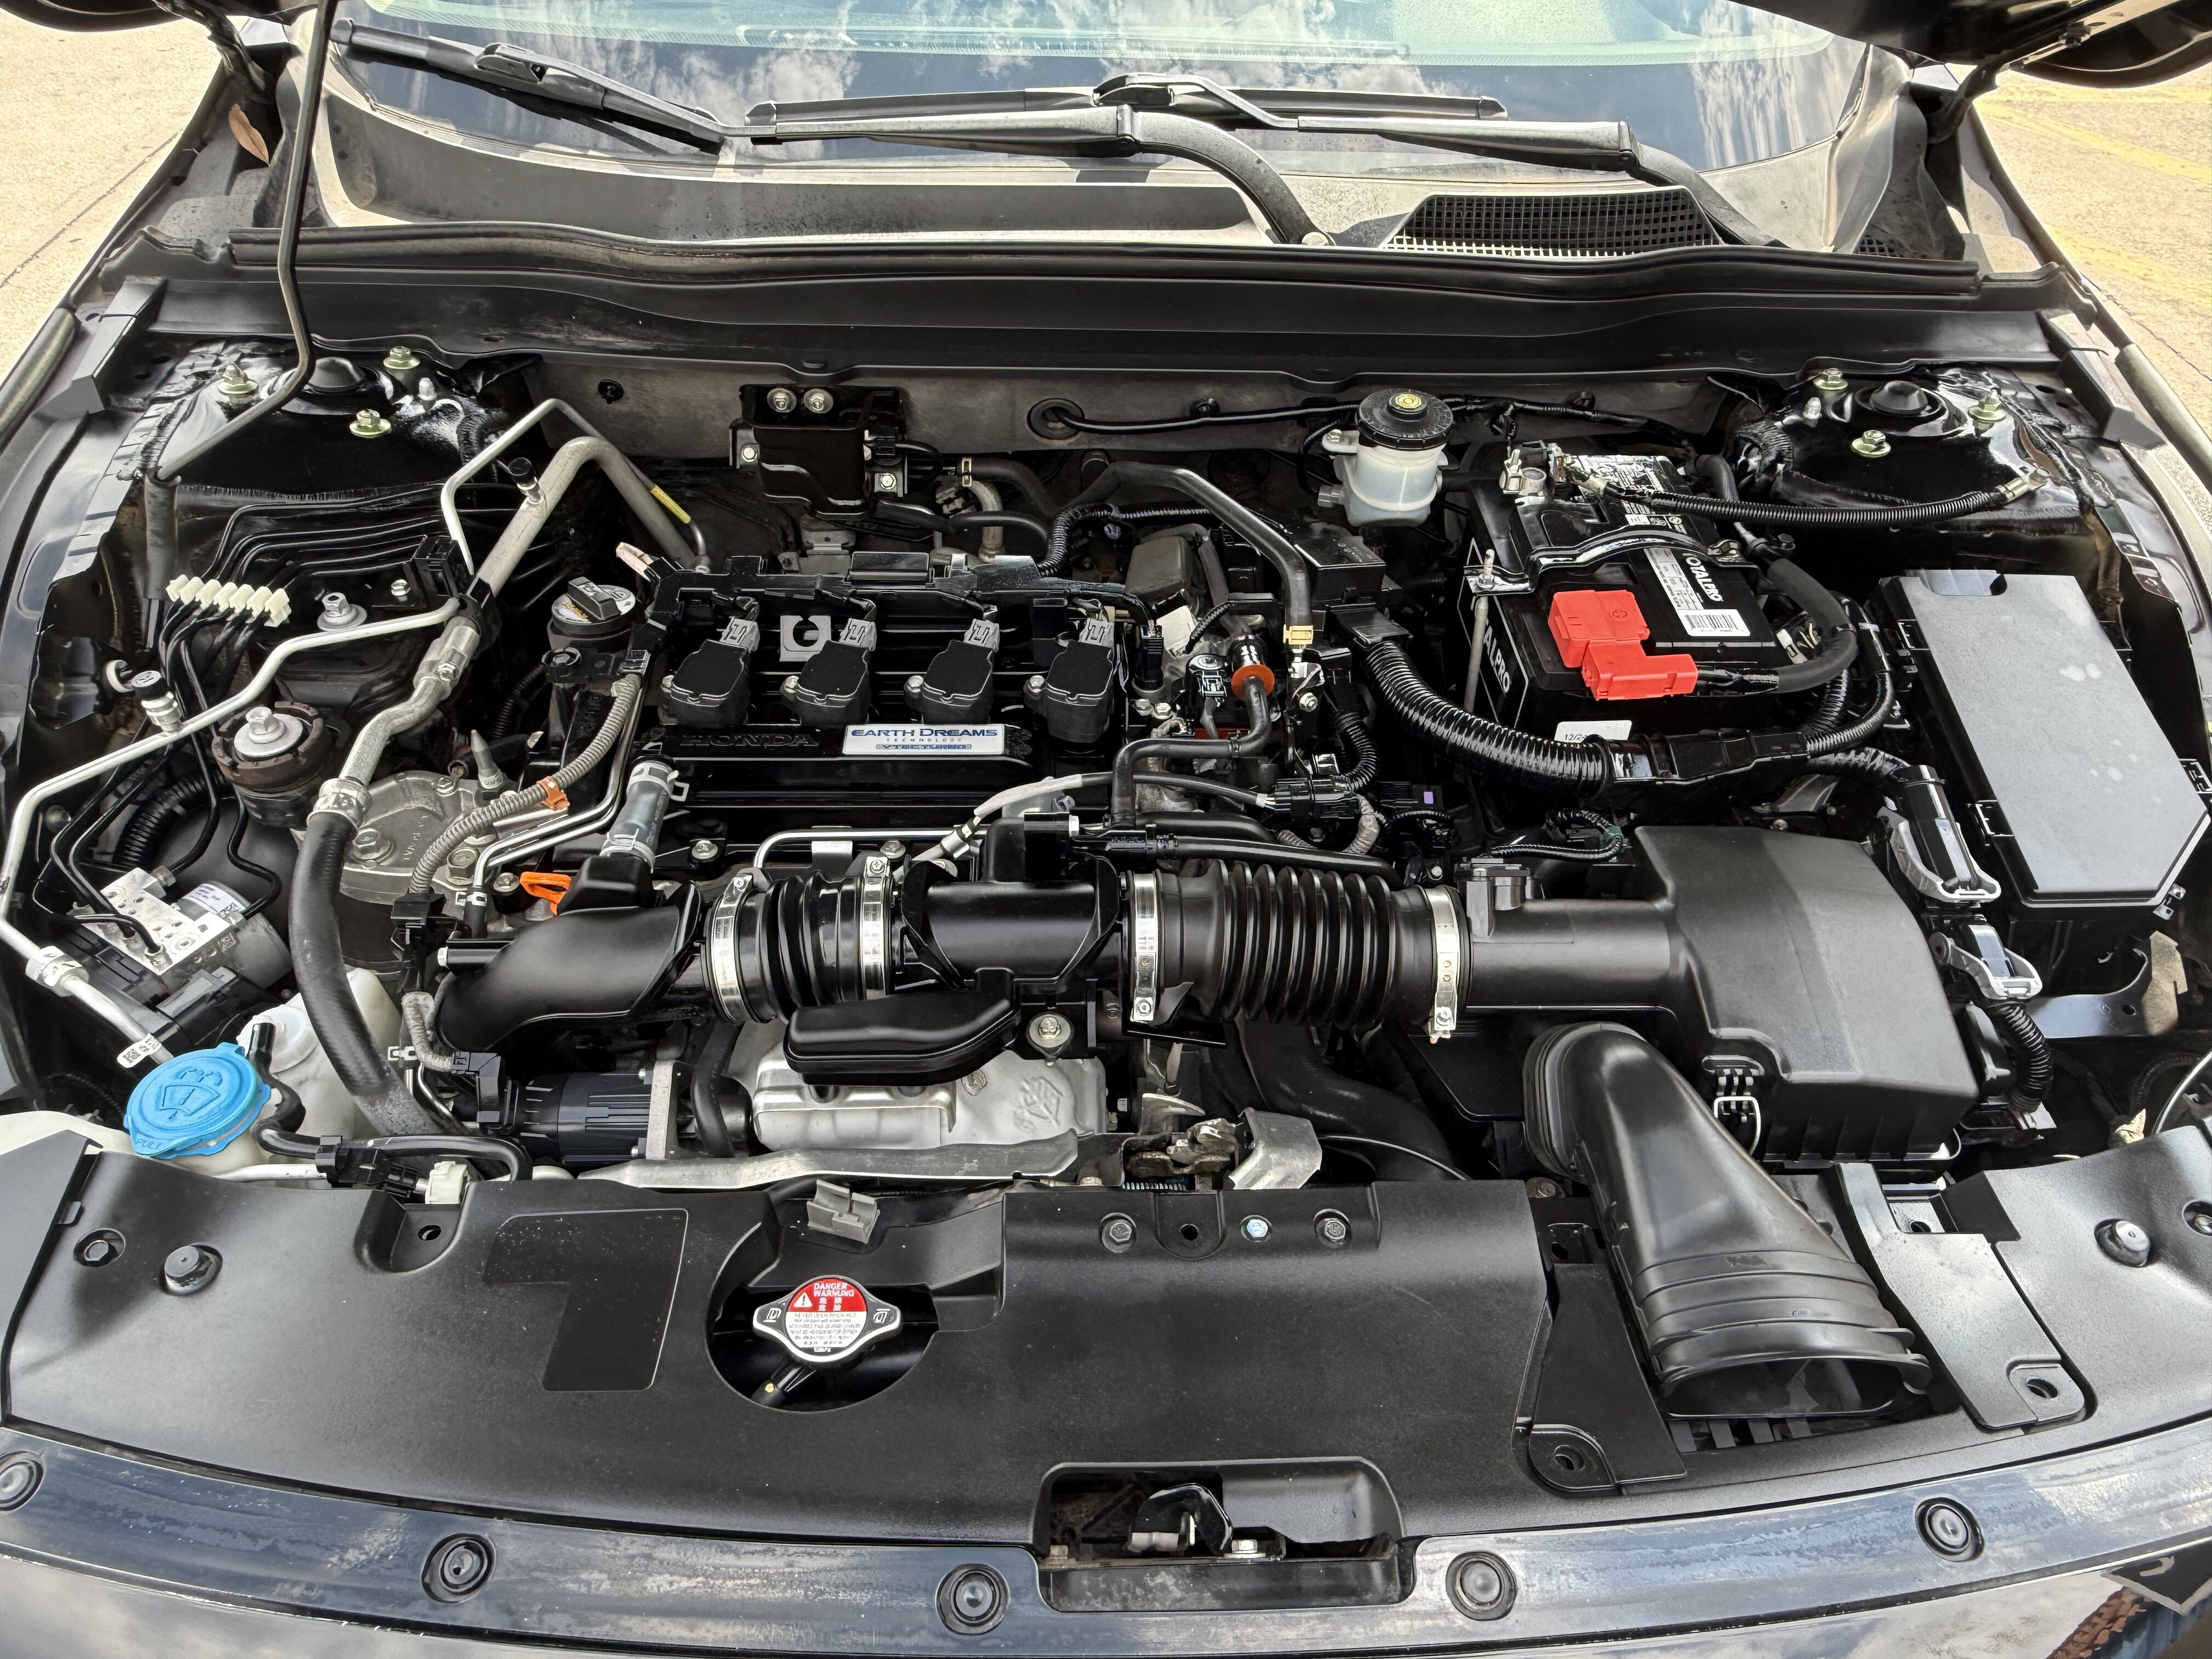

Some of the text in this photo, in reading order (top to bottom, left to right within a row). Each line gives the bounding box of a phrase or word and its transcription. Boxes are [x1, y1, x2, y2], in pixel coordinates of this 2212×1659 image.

[851, 728, 998, 737] EARTH DREAMS
[680, 733, 820, 747] HONDA
[135, 1138, 162, 1150] PULL
